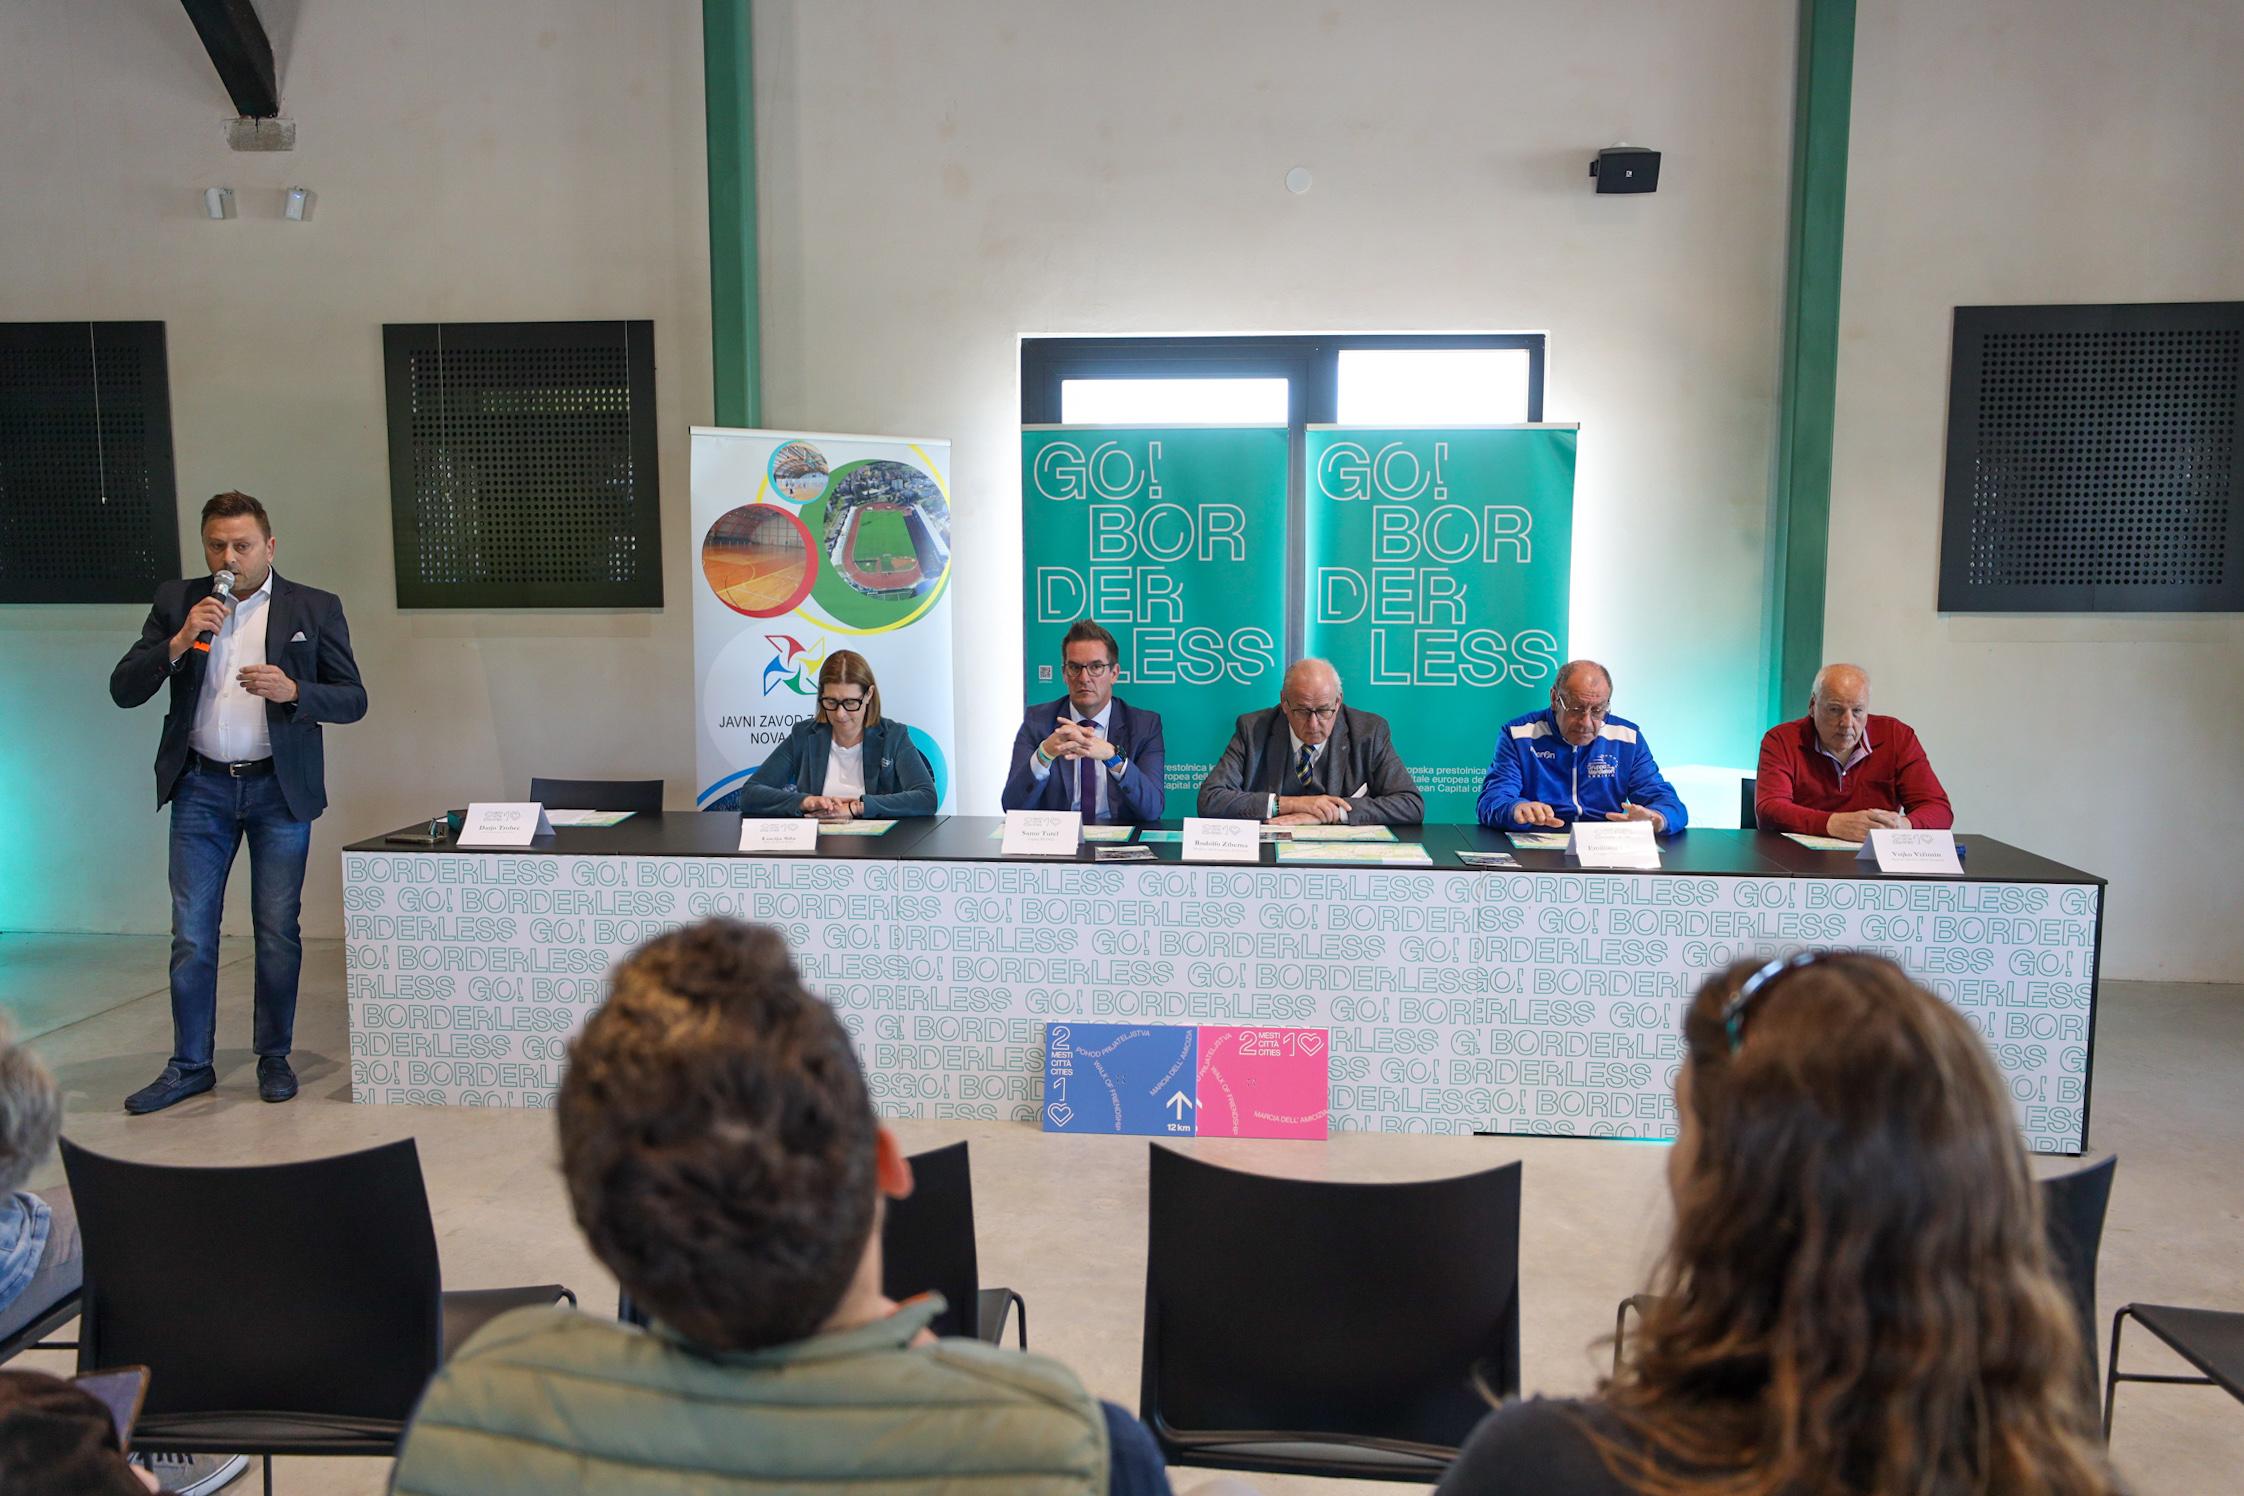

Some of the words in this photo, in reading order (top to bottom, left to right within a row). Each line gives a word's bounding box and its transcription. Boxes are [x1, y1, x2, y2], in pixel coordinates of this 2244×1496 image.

[1034, 441, 1162, 501] GO!
[1317, 441, 1449, 501] GO!
[1089, 503, 1246, 562] BOR
[1372, 504, 1533, 564] BOR
[1037, 566, 1184, 624] DER
[1317, 566, 1468, 625] DER
[1118, 627, 1275, 685] ESS
[1370, 628, 1558, 688] LESS
[719, 715, 756, 728] JAVNI
[750, 732, 785, 744] NOVA
[1432, 776, 1470, 784] europea
[1436, 766, 1487, 775] prestolnica
[1437, 784, 1470, 793] Capital
[347, 857, 560, 886] BORDERLESS
[571, 860, 628, 887] GO!
[637, 862, 854, 890] BORDERLESS
[903, 866, 1125, 897] BORDERLESS
[1138, 871, 1197, 897] GO!
[1207, 872, 1434, 903] BORDERLESS
[397, 887, 453, 912] GO!
[462, 887, 675, 917] BORDERLESS
[688, 891, 745, 917] GO!
[1484, 875, 1719, 907] BORDERLESS
[1734, 880, 1796, 909] GO!
[1805, 882, 2048, 915] BORDERLESS
[955, 897, 1012, 924] GO!
[1022, 898, 1246, 928] BORDERLESS
[1259, 903, 1318, 930] GO!
[1538, 907, 1600, 934] GO!
[1609, 909, 1847, 941] BORDERLESS
[1861, 914, 1924, 943] GO!
[529, 918, 585, 944] GO!
[823, 923, 880, 950] GO!
[1092, 929, 1150, 956] GO!
[1160, 931, 1386, 961] BORDERLESS
[1400, 936, 1460, 963] GO!
[398, 945, 609, 974] BORDERLESS
[953, 957, 1175, 987] BORDERLESS
[1187, 961, 1247, 988] GO!
[2009, 949, 2073, 977] GO!
[468, 976, 523, 1002] GO!
[363, 1003, 573, 1033] BORDERLESS
[1025, 988, 1084, 1015] GO!
[1093, 989, 1316, 1020] BORDERLESS
[1330, 996, 1390, 1023] GO!
[1609, 1002, 1671, 1029] GO!
[1052, 1025, 1071, 1051] 2
[1239, 1030, 1258, 1056] 2
[1051, 1051, 1073, 1059] MESTI
[1380, 1056, 1440, 1084] GO!
[1050, 1068, 1073, 1076] CITIES
[1105, 1079, 1114, 1089] OF
[1167, 1123, 1177, 1132] 12
[1177, 1123, 1191, 1132] km
[1254, 1110, 1281, 1122] MARCIA
